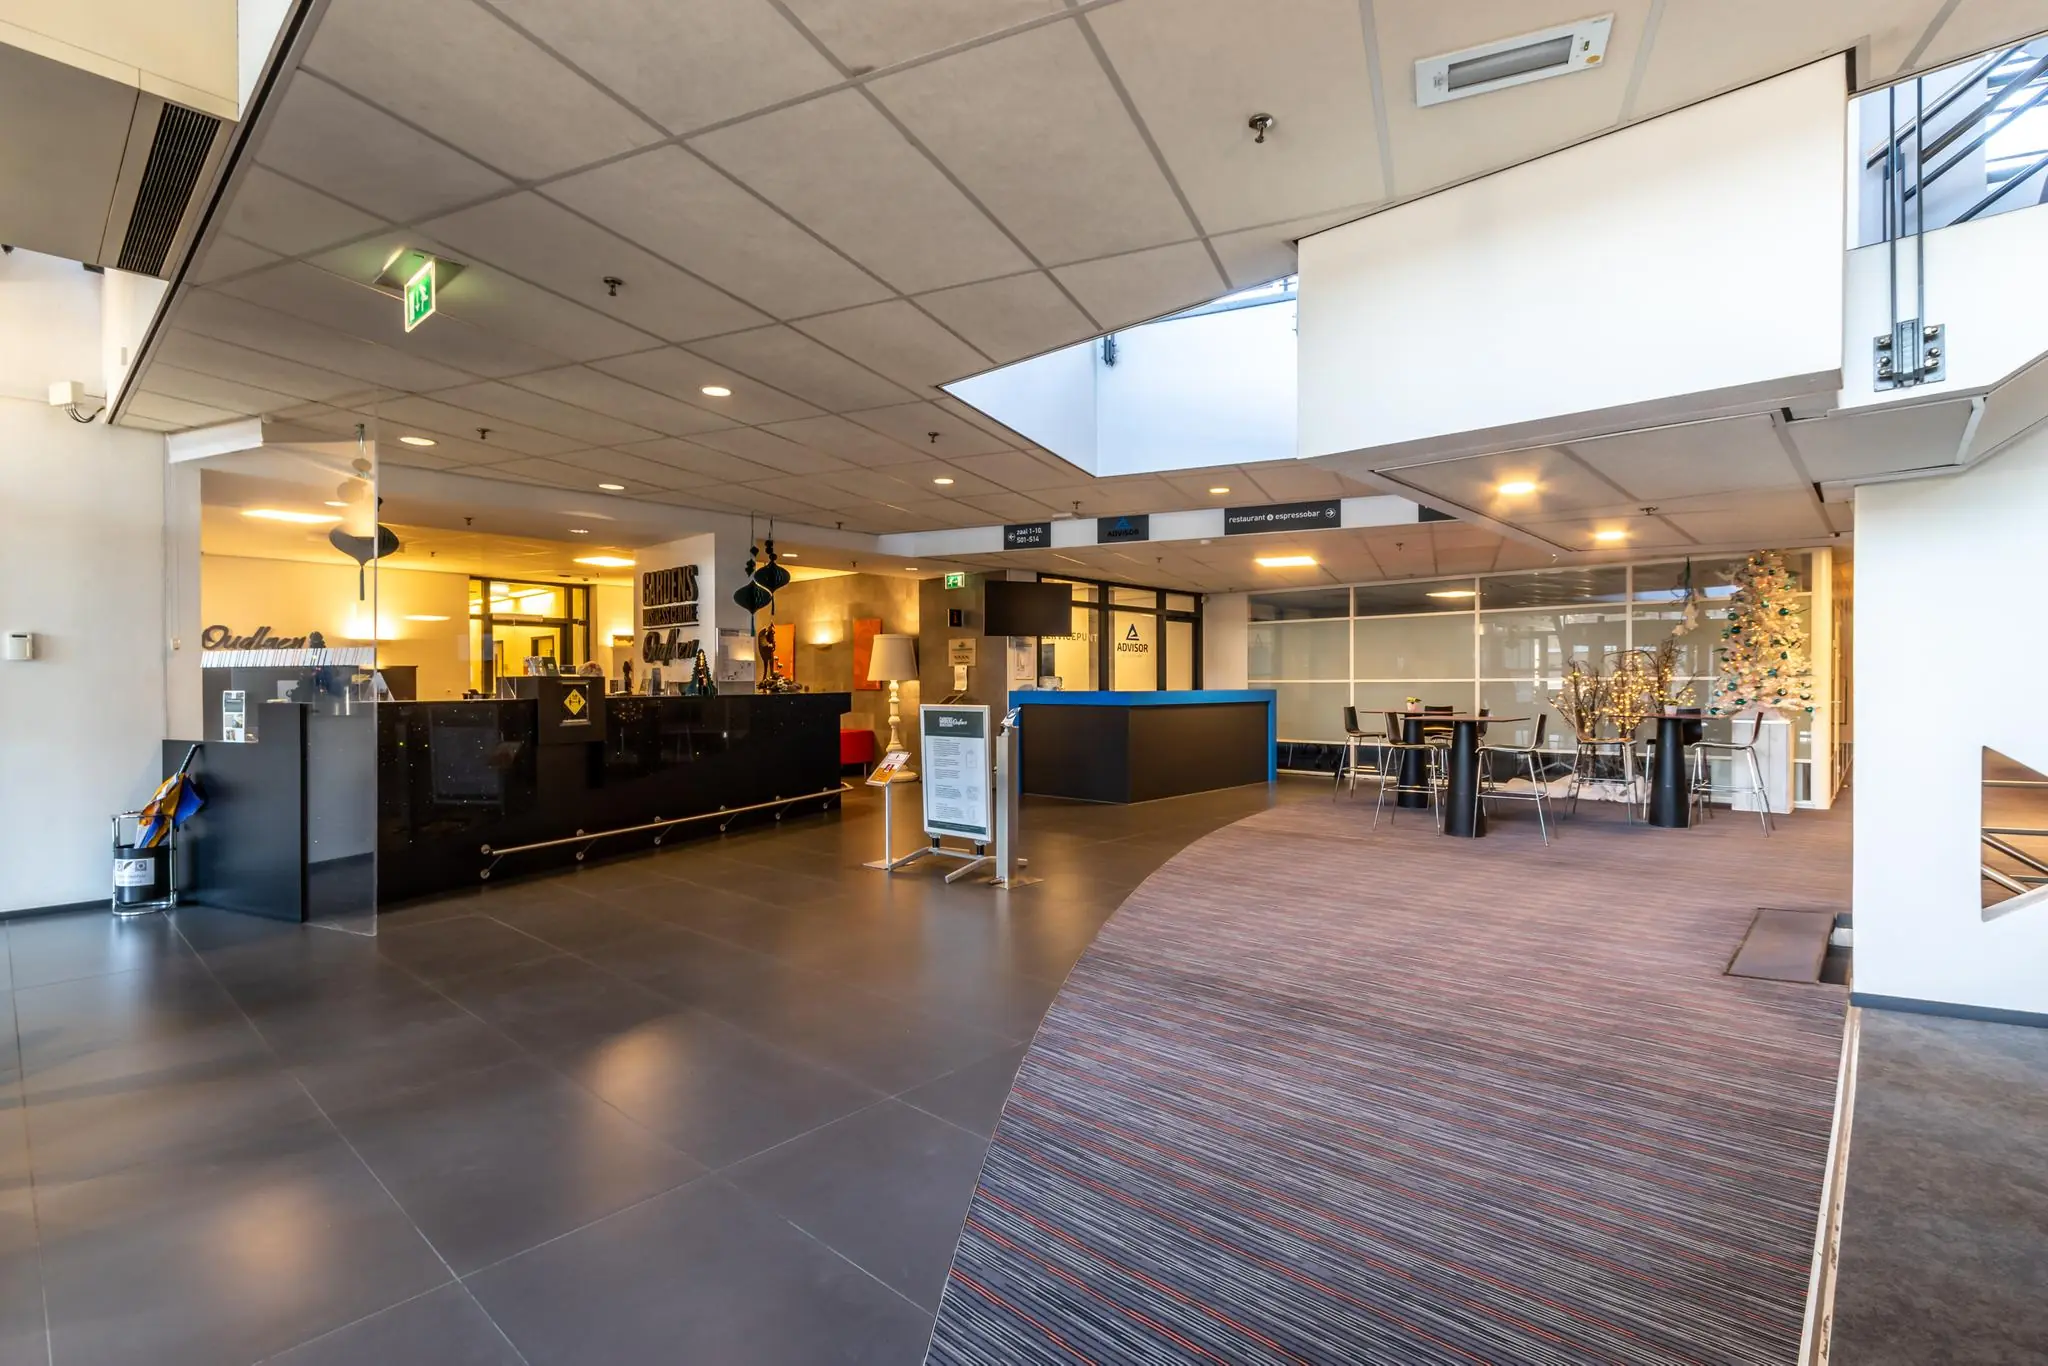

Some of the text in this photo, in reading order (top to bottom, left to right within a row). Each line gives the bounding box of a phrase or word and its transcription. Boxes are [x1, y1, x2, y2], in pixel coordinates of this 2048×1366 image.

[1229, 514, 1265, 523] restaurant
[1275, 510, 1321, 520] espressobar
[643, 565, 699, 606] GARDENS
[1117, 642, 1149, 653] ADVISOR
